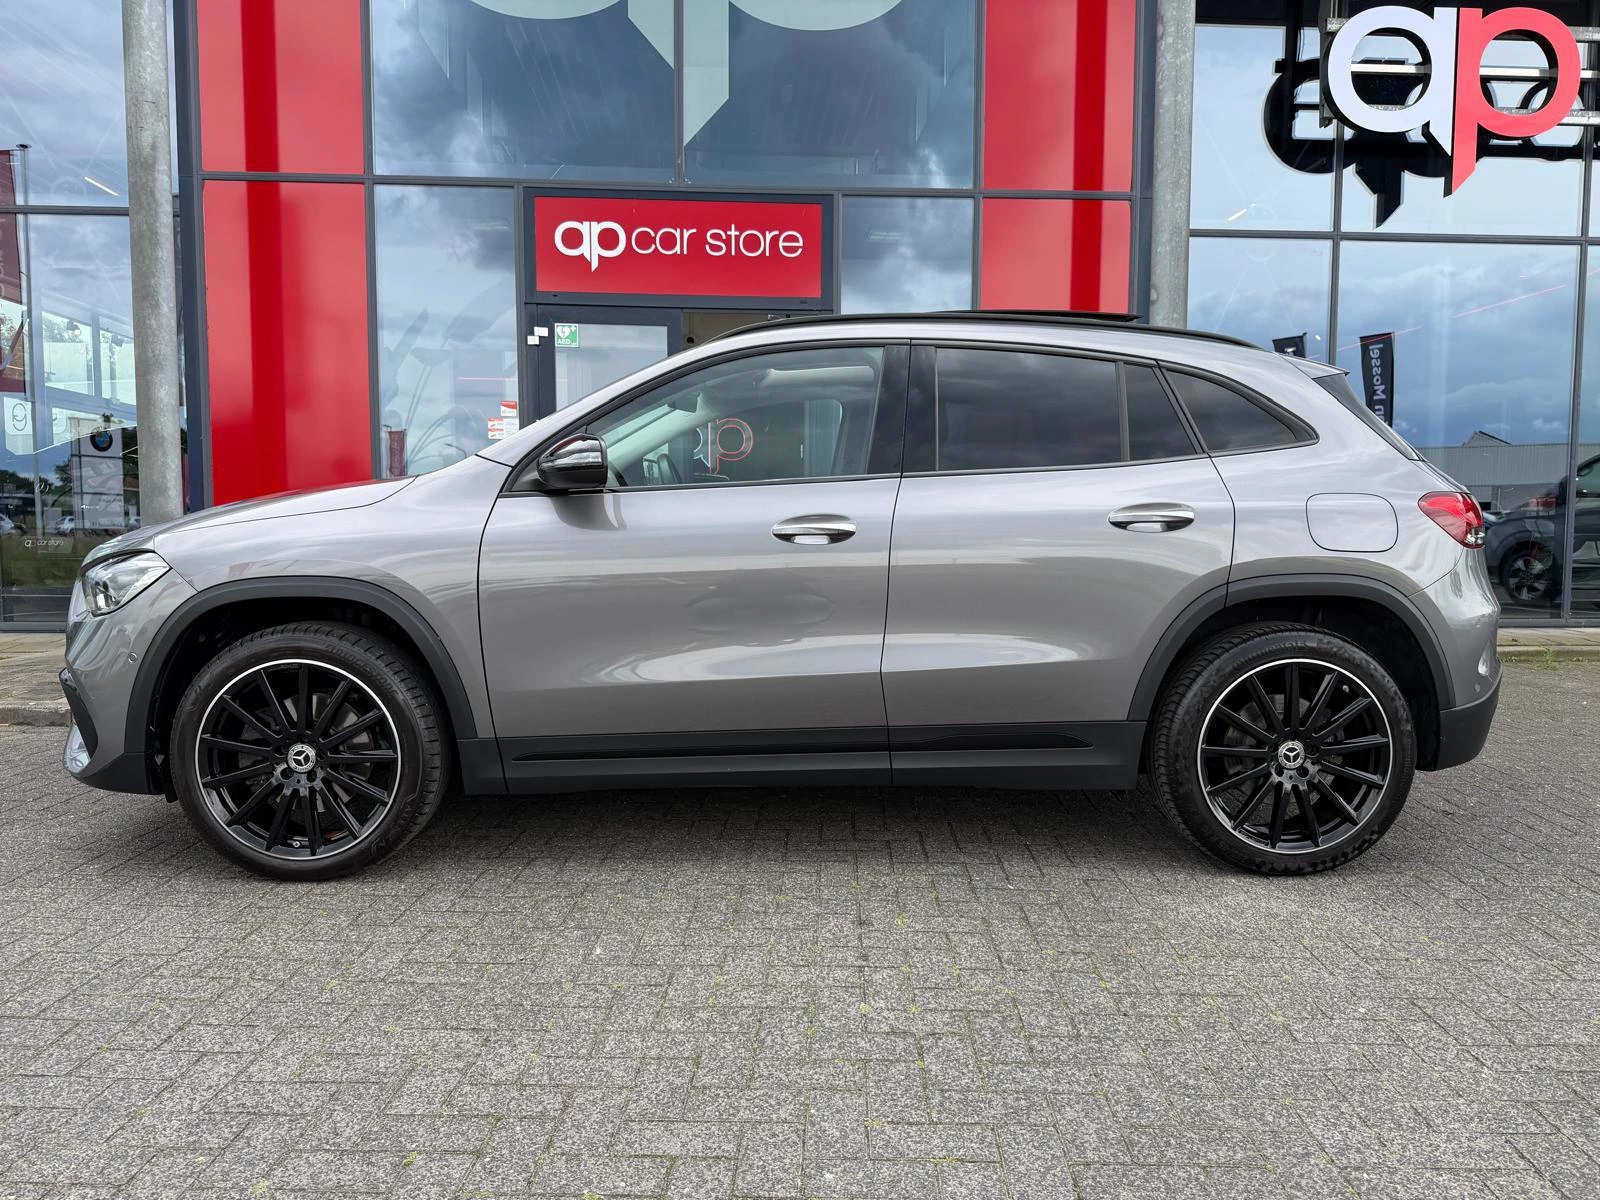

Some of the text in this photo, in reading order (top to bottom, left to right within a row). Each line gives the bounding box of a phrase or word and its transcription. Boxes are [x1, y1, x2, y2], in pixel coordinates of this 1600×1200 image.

[1327, 5, 1581, 196] ap
[554, 220, 804, 273] ap car store
